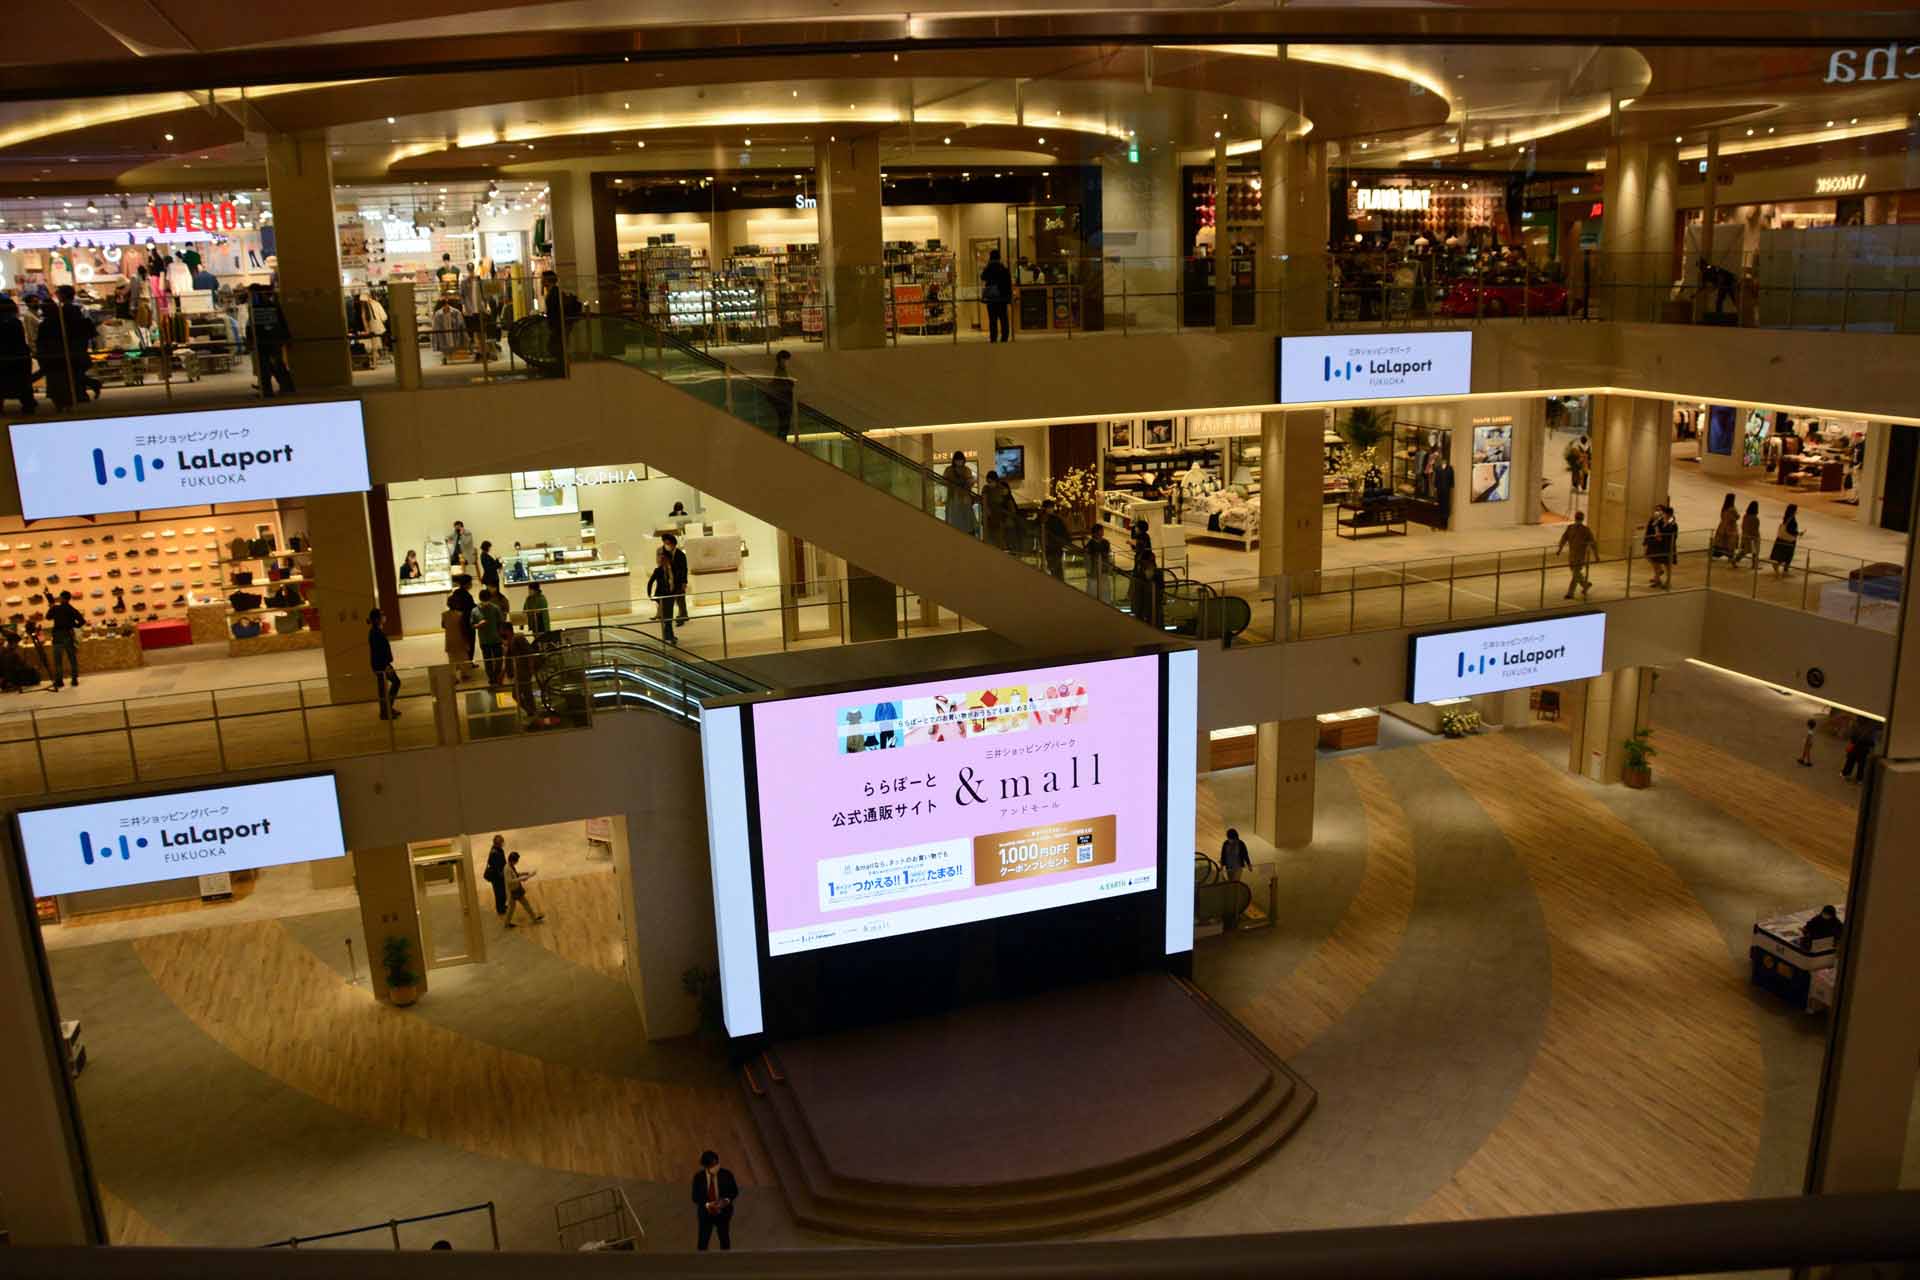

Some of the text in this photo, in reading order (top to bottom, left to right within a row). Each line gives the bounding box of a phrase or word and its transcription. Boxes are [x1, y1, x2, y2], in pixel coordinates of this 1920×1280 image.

[152, 201, 237, 234] WEGO
[1369, 359, 1433, 377] LaLaport
[135, 427, 250, 447] 三井ショッピングパーク
[177, 444, 294, 471] LaLaport
[181, 473, 247, 488] FUKUOKA
[575, 469, 639, 486] SOPHIA
[1503, 645, 1566, 666] LaLaport
[985, 739, 1076, 760] 三井ショッピングパーク
[863, 772, 937, 797] ららぽーと
[119, 805, 230, 828] 三井ショッピングパーク
[831, 799, 937, 828] 公式通販サイト
[1000, 802, 1060, 817] アンドモール
[160, 818, 271, 848] LaLaport
[164, 847, 227, 864] FUKUOKA
